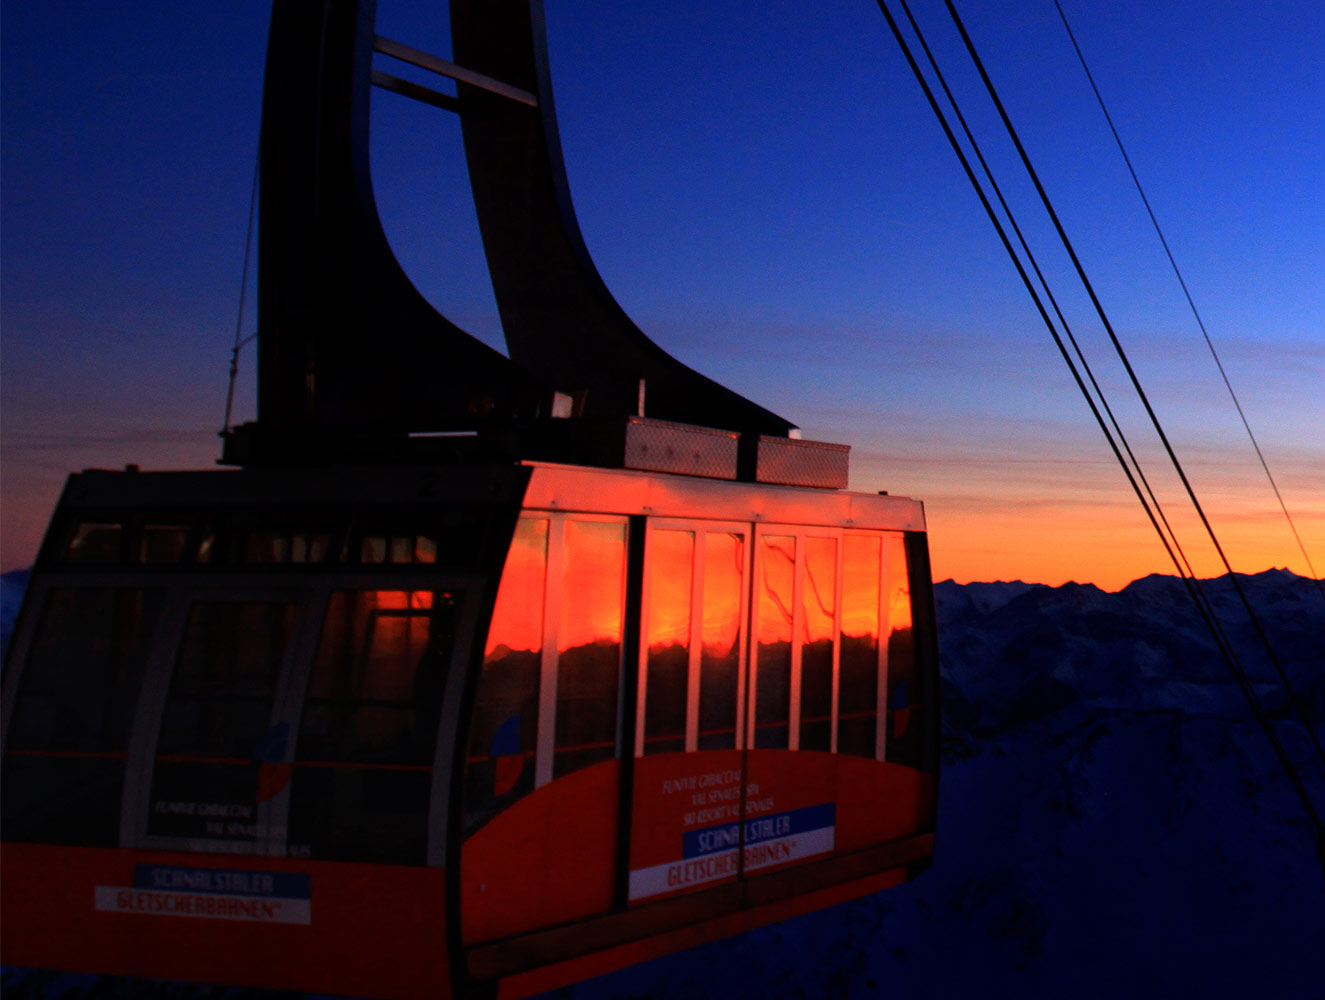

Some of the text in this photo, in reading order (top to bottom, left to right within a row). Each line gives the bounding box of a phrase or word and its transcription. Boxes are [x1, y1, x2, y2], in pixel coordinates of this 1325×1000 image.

[698, 815, 790, 852] SCHNALSTALER
[152, 867, 273, 893] SCHNALSTALER
[667, 841, 791, 887] GLETSCHERBAHNEN
[117, 890, 274, 917] GLETSCHERBAHNEN
